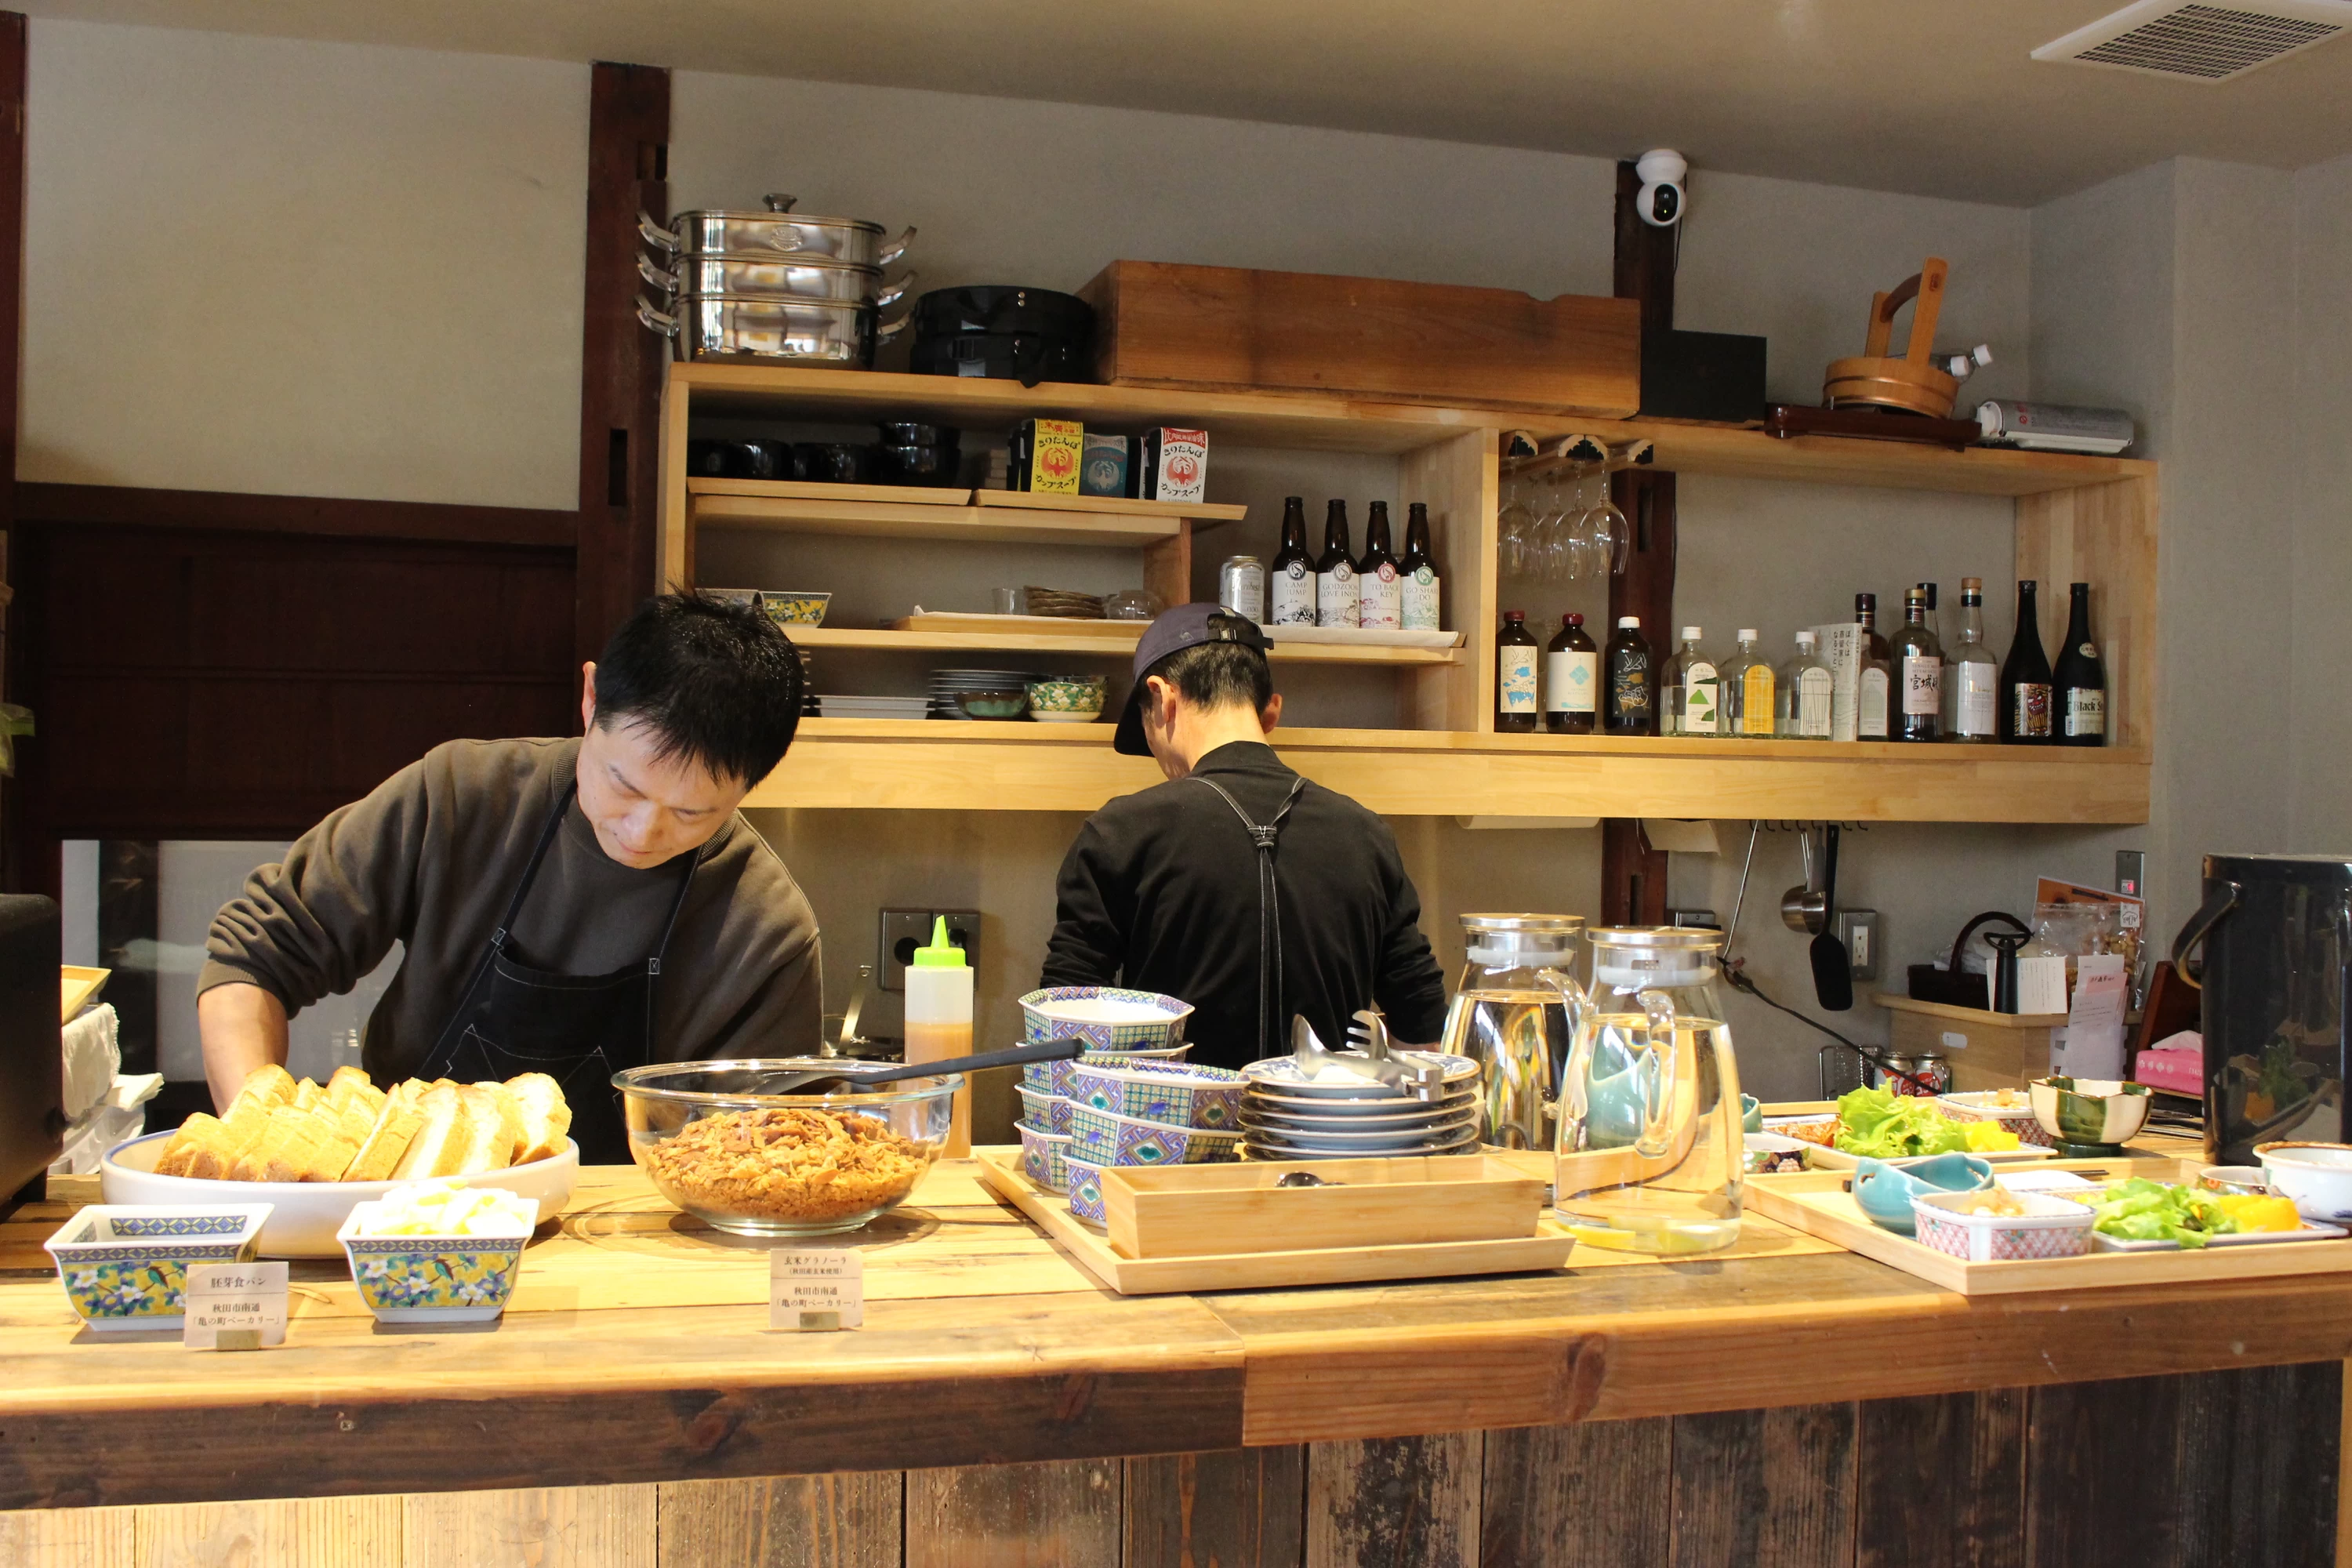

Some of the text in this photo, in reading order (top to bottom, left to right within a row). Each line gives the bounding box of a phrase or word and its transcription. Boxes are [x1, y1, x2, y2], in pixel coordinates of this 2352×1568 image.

[1038, 436, 1081, 450] きりたんぽ
[1163, 445, 1205, 458] きりたんぽ
[1036, 474, 1076, 489] カップスープ
[1161, 482, 1201, 497] カップスープ
[2074, 701, 2096, 711] Black
[784, 1256, 847, 1265] 玄米グラノーラ
[211, 1276, 267, 1288] 胚芽食パン
[794, 1287, 838, 1295] 秋田市南通
[212, 1302, 260, 1313] 秋田市南通
